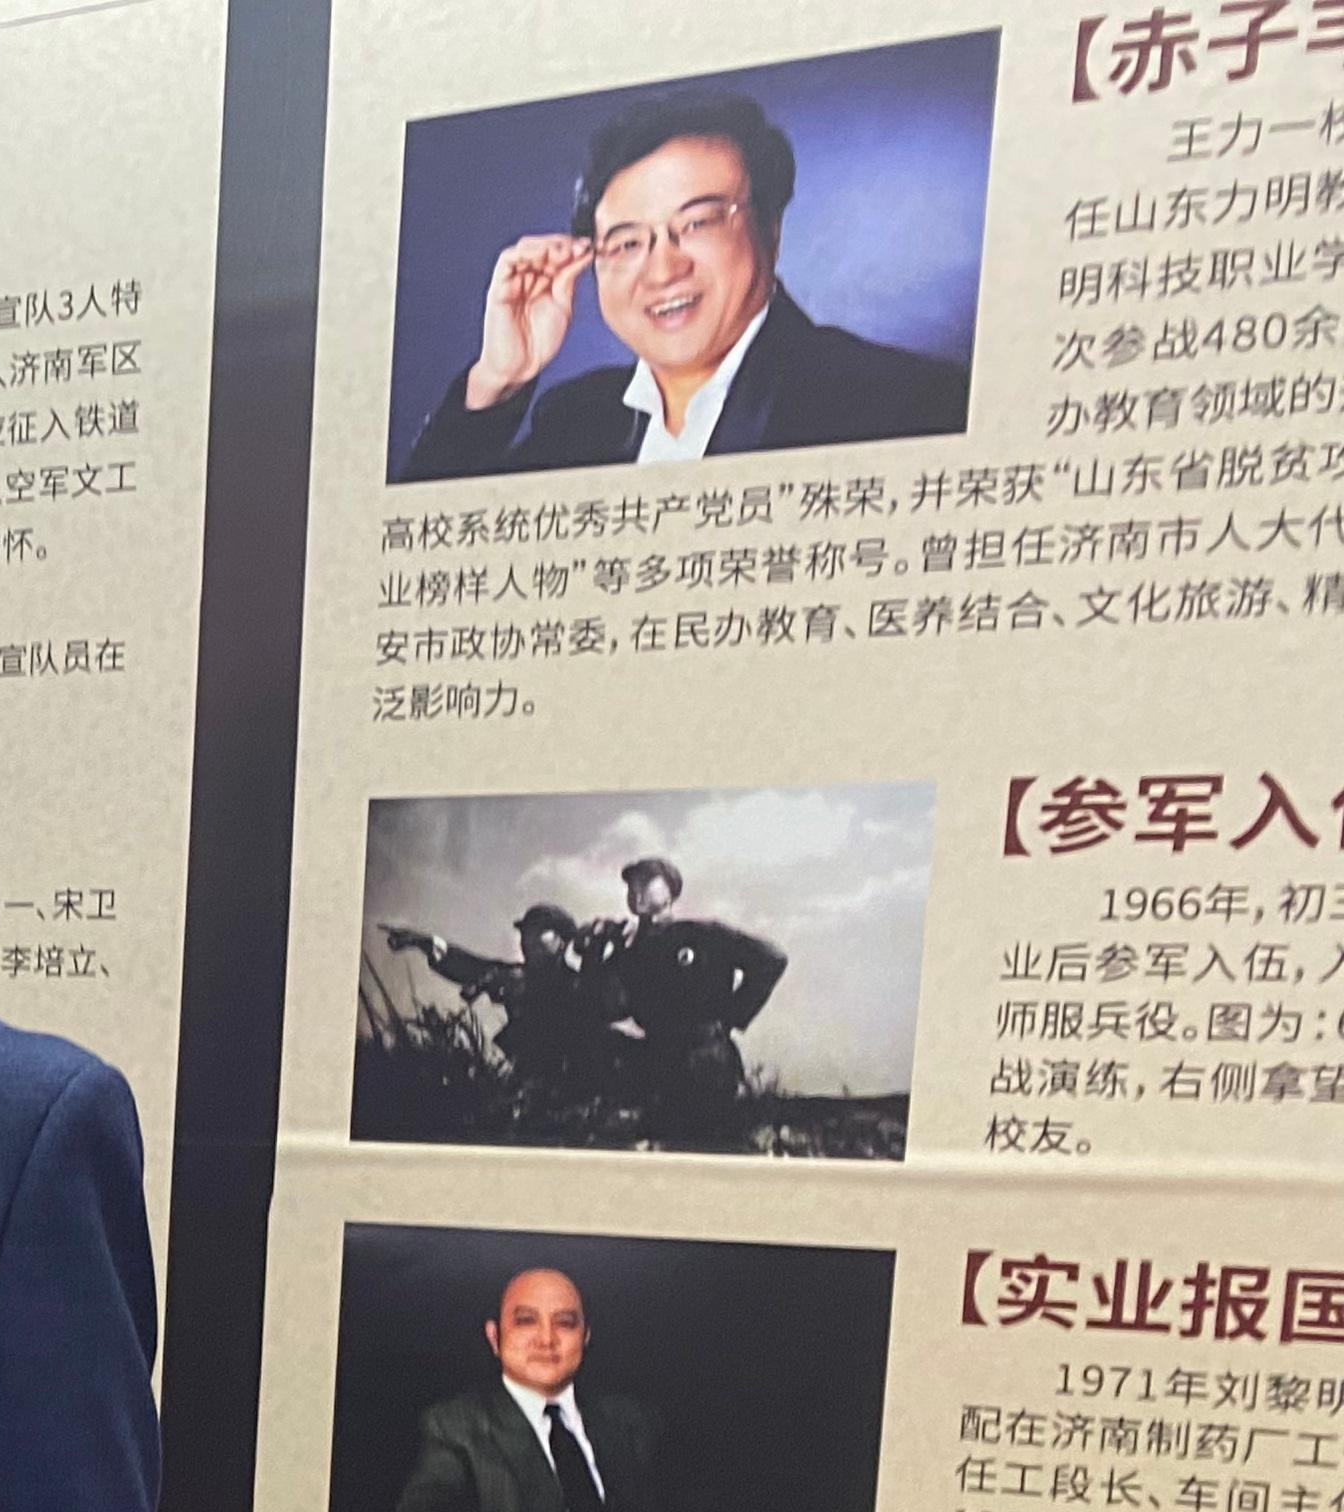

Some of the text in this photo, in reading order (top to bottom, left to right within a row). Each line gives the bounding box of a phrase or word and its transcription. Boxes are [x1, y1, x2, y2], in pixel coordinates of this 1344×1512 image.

[1052, 303, 1342, 372] 次参战480余
[1046, 369, 1344, 438] 办教育领域的
[372, 678, 535, 722] 泛影响力。
[1003, 770, 1344, 857] 【参军入
[996, 1000, 1344, 1044] 师服兵役。图为：
[984, 1113, 1092, 1156] 校友。
[961, 1249, 1344, 1346] 【实业报国
[959, 1404, 1340, 1470] 配在济南制药厂工
